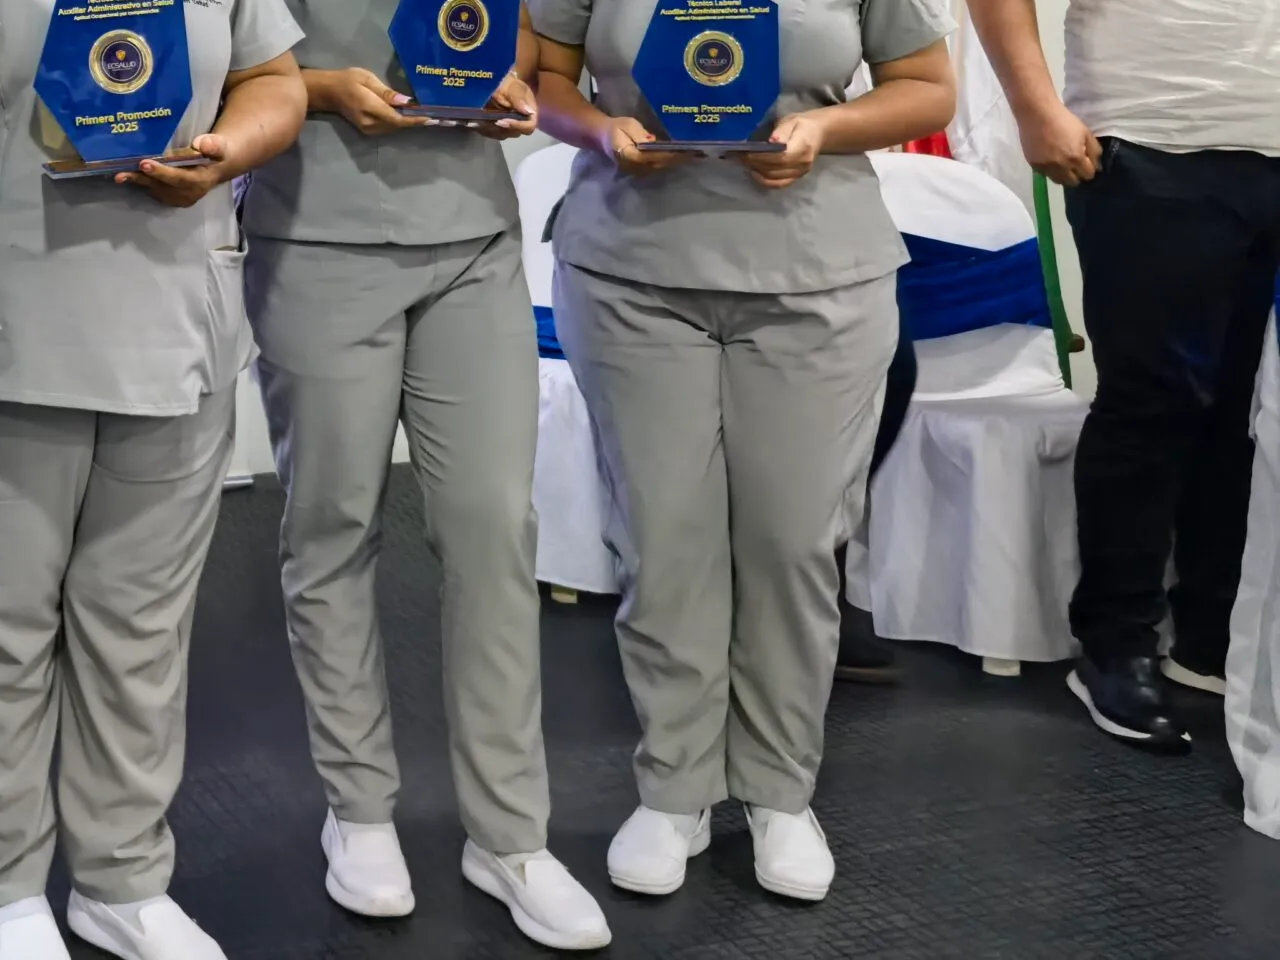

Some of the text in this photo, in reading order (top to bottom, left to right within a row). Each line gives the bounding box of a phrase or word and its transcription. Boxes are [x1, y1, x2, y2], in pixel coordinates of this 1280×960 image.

[58, 7, 86, 16] Auxiliar
[87, 2, 141, 13] Administrativo
[416, 64, 448, 76] Primera
[443, 77, 465, 87] 2025
[662, 105, 698, 113] Primera
[75, 107, 171, 126] Primera Promoción
[694, 114, 720, 123] 2025
[111, 121, 139, 134] 2025
